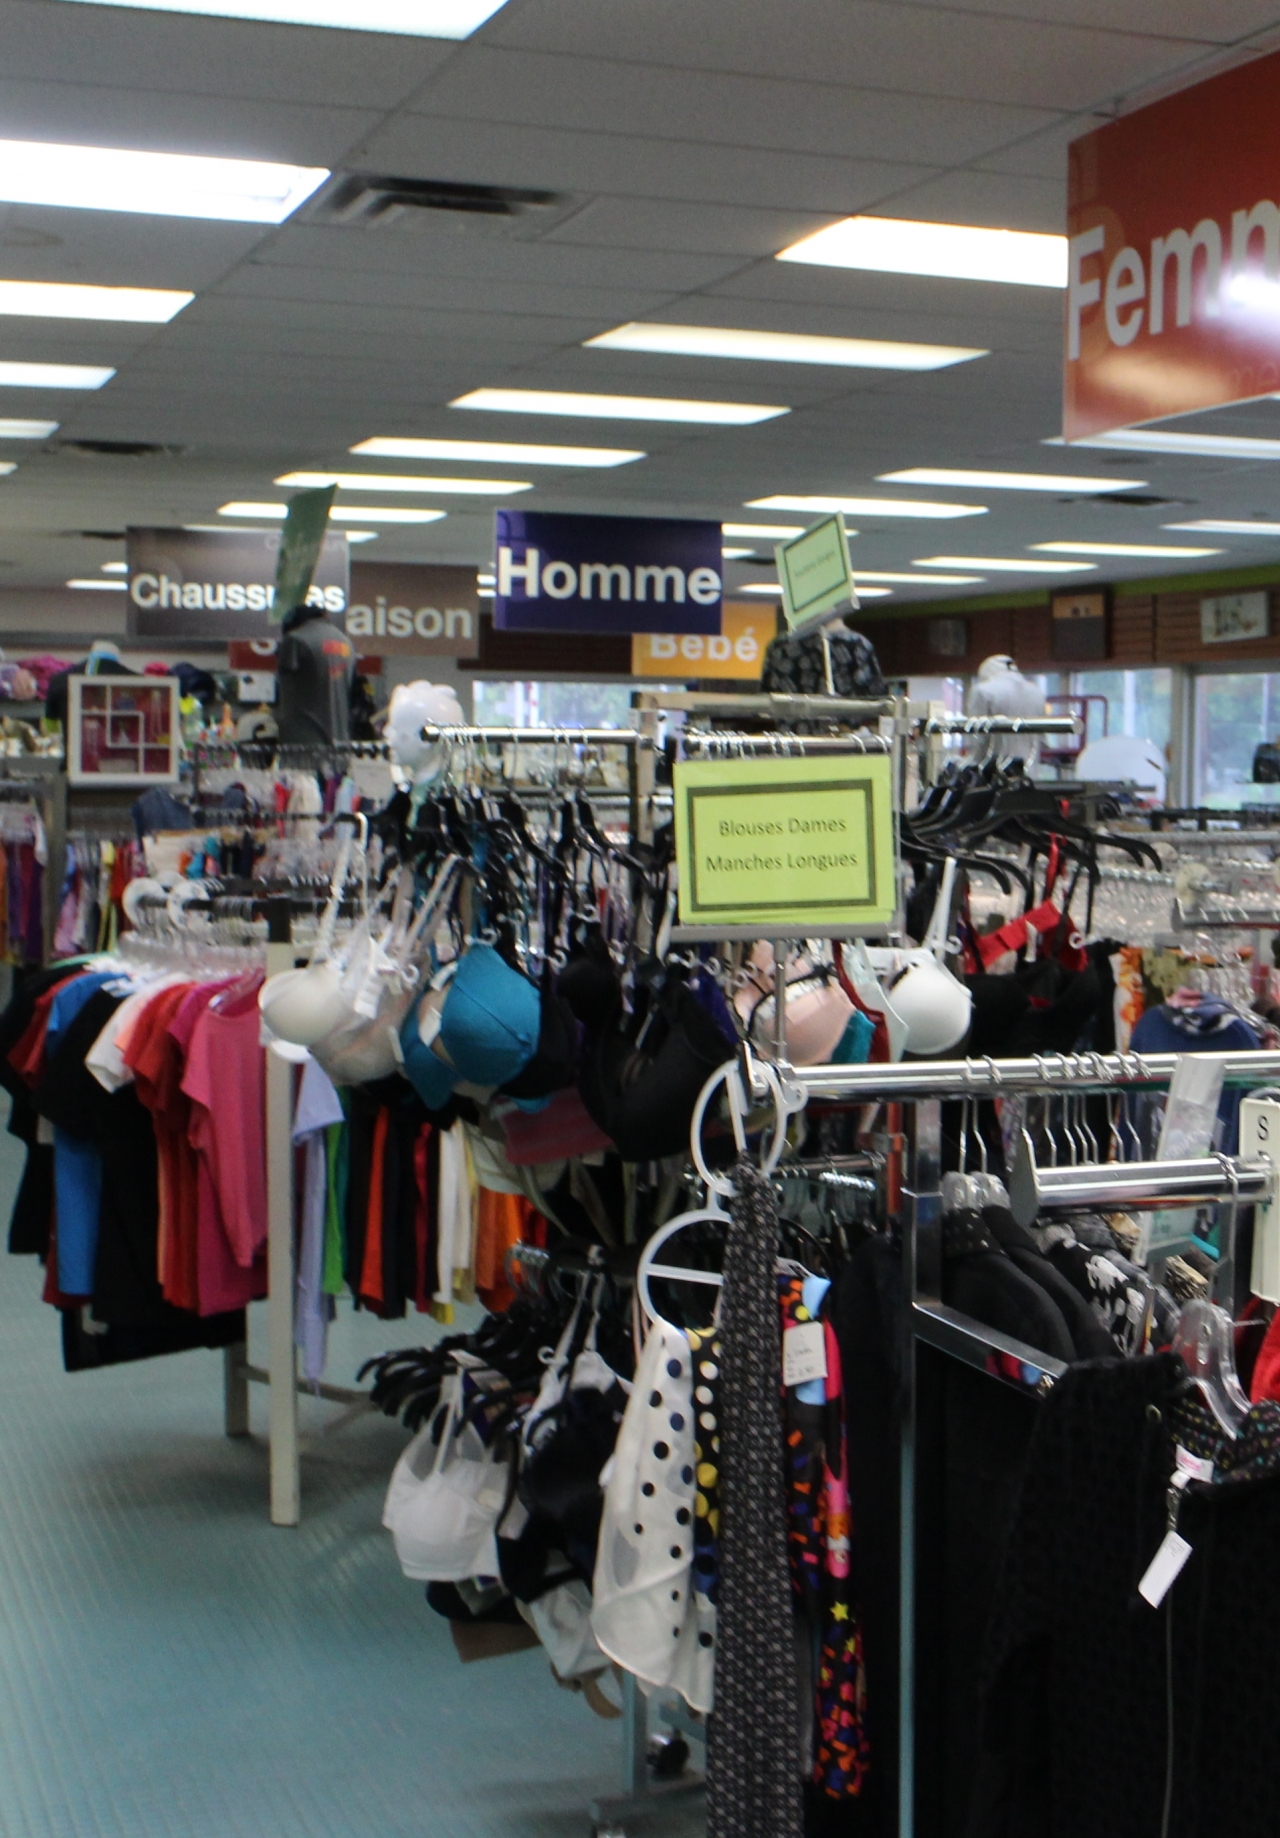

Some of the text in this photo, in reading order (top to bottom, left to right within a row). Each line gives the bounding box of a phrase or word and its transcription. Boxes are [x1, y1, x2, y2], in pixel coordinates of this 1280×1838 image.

[498, 547, 722, 604] Homme
[131, 573, 346, 613] Chausses
[346, 596, 473, 640] aison
[719, 817, 847, 836] Blouses Dames
[706, 852, 858, 872] Manches Longues
[1256, 1115, 1269, 1140] S
